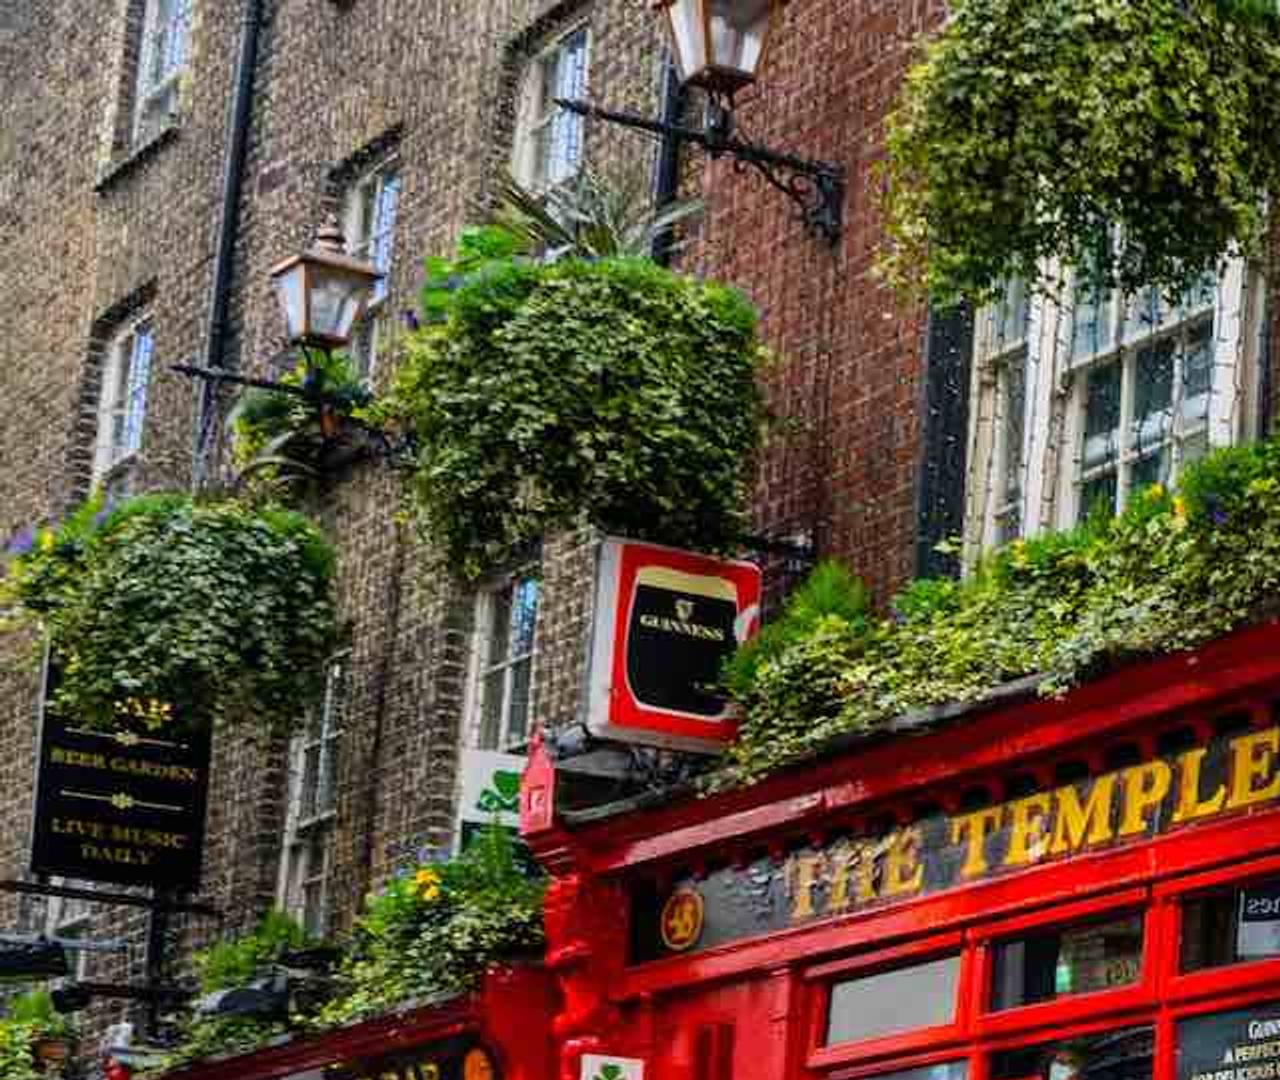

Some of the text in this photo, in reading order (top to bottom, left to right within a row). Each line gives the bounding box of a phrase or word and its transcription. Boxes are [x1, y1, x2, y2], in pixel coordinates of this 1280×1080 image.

[639, 612, 725, 641] GUINNESS
[52, 815, 190, 848] LIVE MUSIC
[79, 843, 156, 867] DAILY
[784, 826, 928, 922] THE
